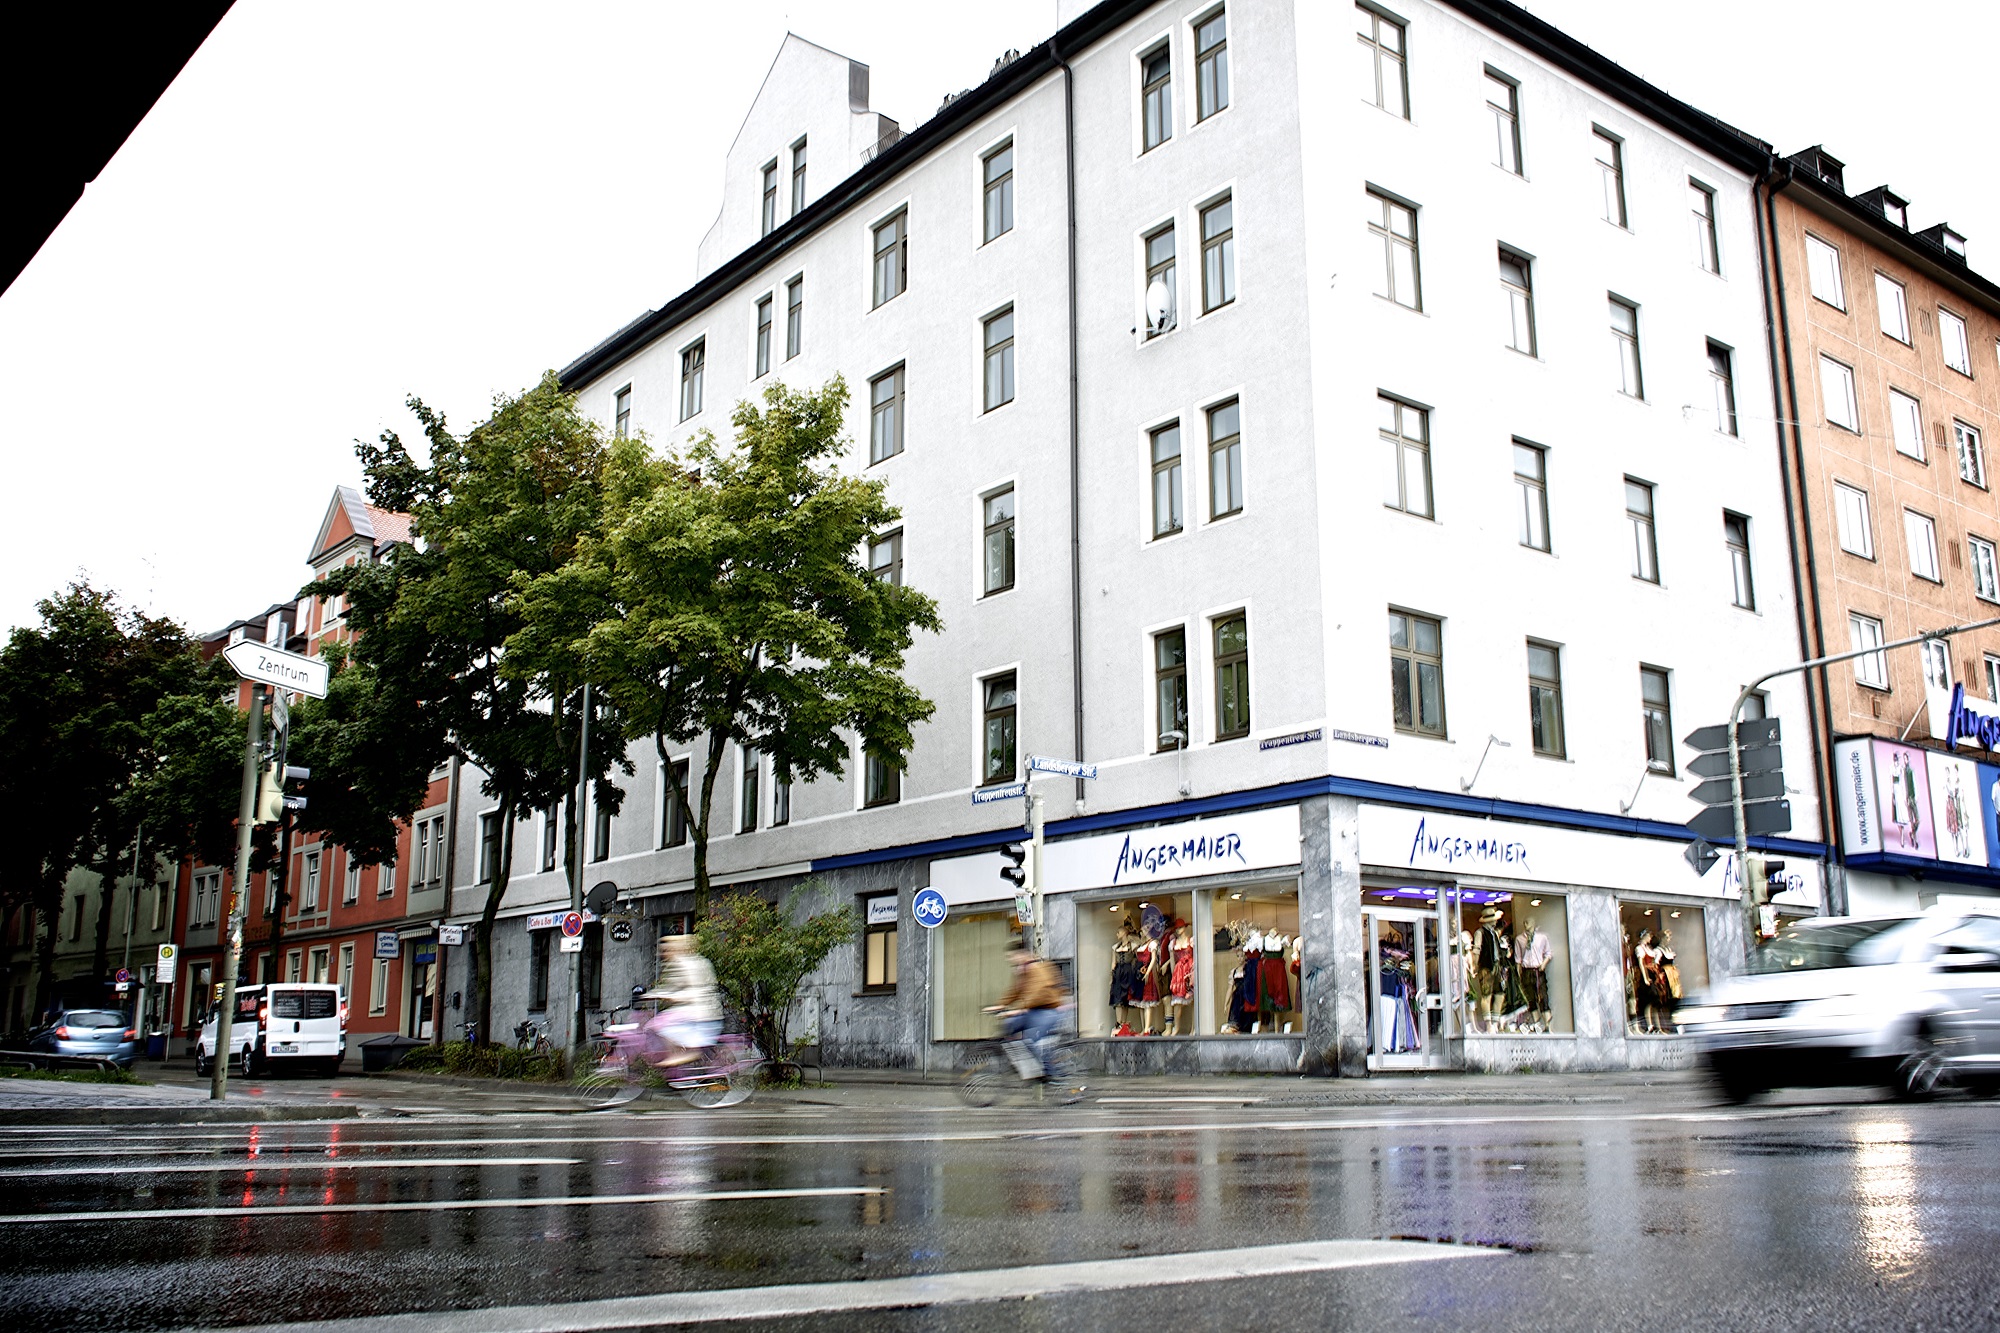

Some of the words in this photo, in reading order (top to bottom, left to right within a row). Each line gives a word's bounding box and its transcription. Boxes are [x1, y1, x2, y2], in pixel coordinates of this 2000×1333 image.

[258, 655, 309, 683] Zentrum
[1034, 758, 1080, 775] Landsberger
[1082, 766, 1095, 777] Str.
[1851, 750, 1869, 846] www.angermaier.de
[1113, 833, 1246, 884] ANGERMAIER
[1410, 816, 1531, 873] ANGERMAIER
[552, 913, 567, 925] IPO
